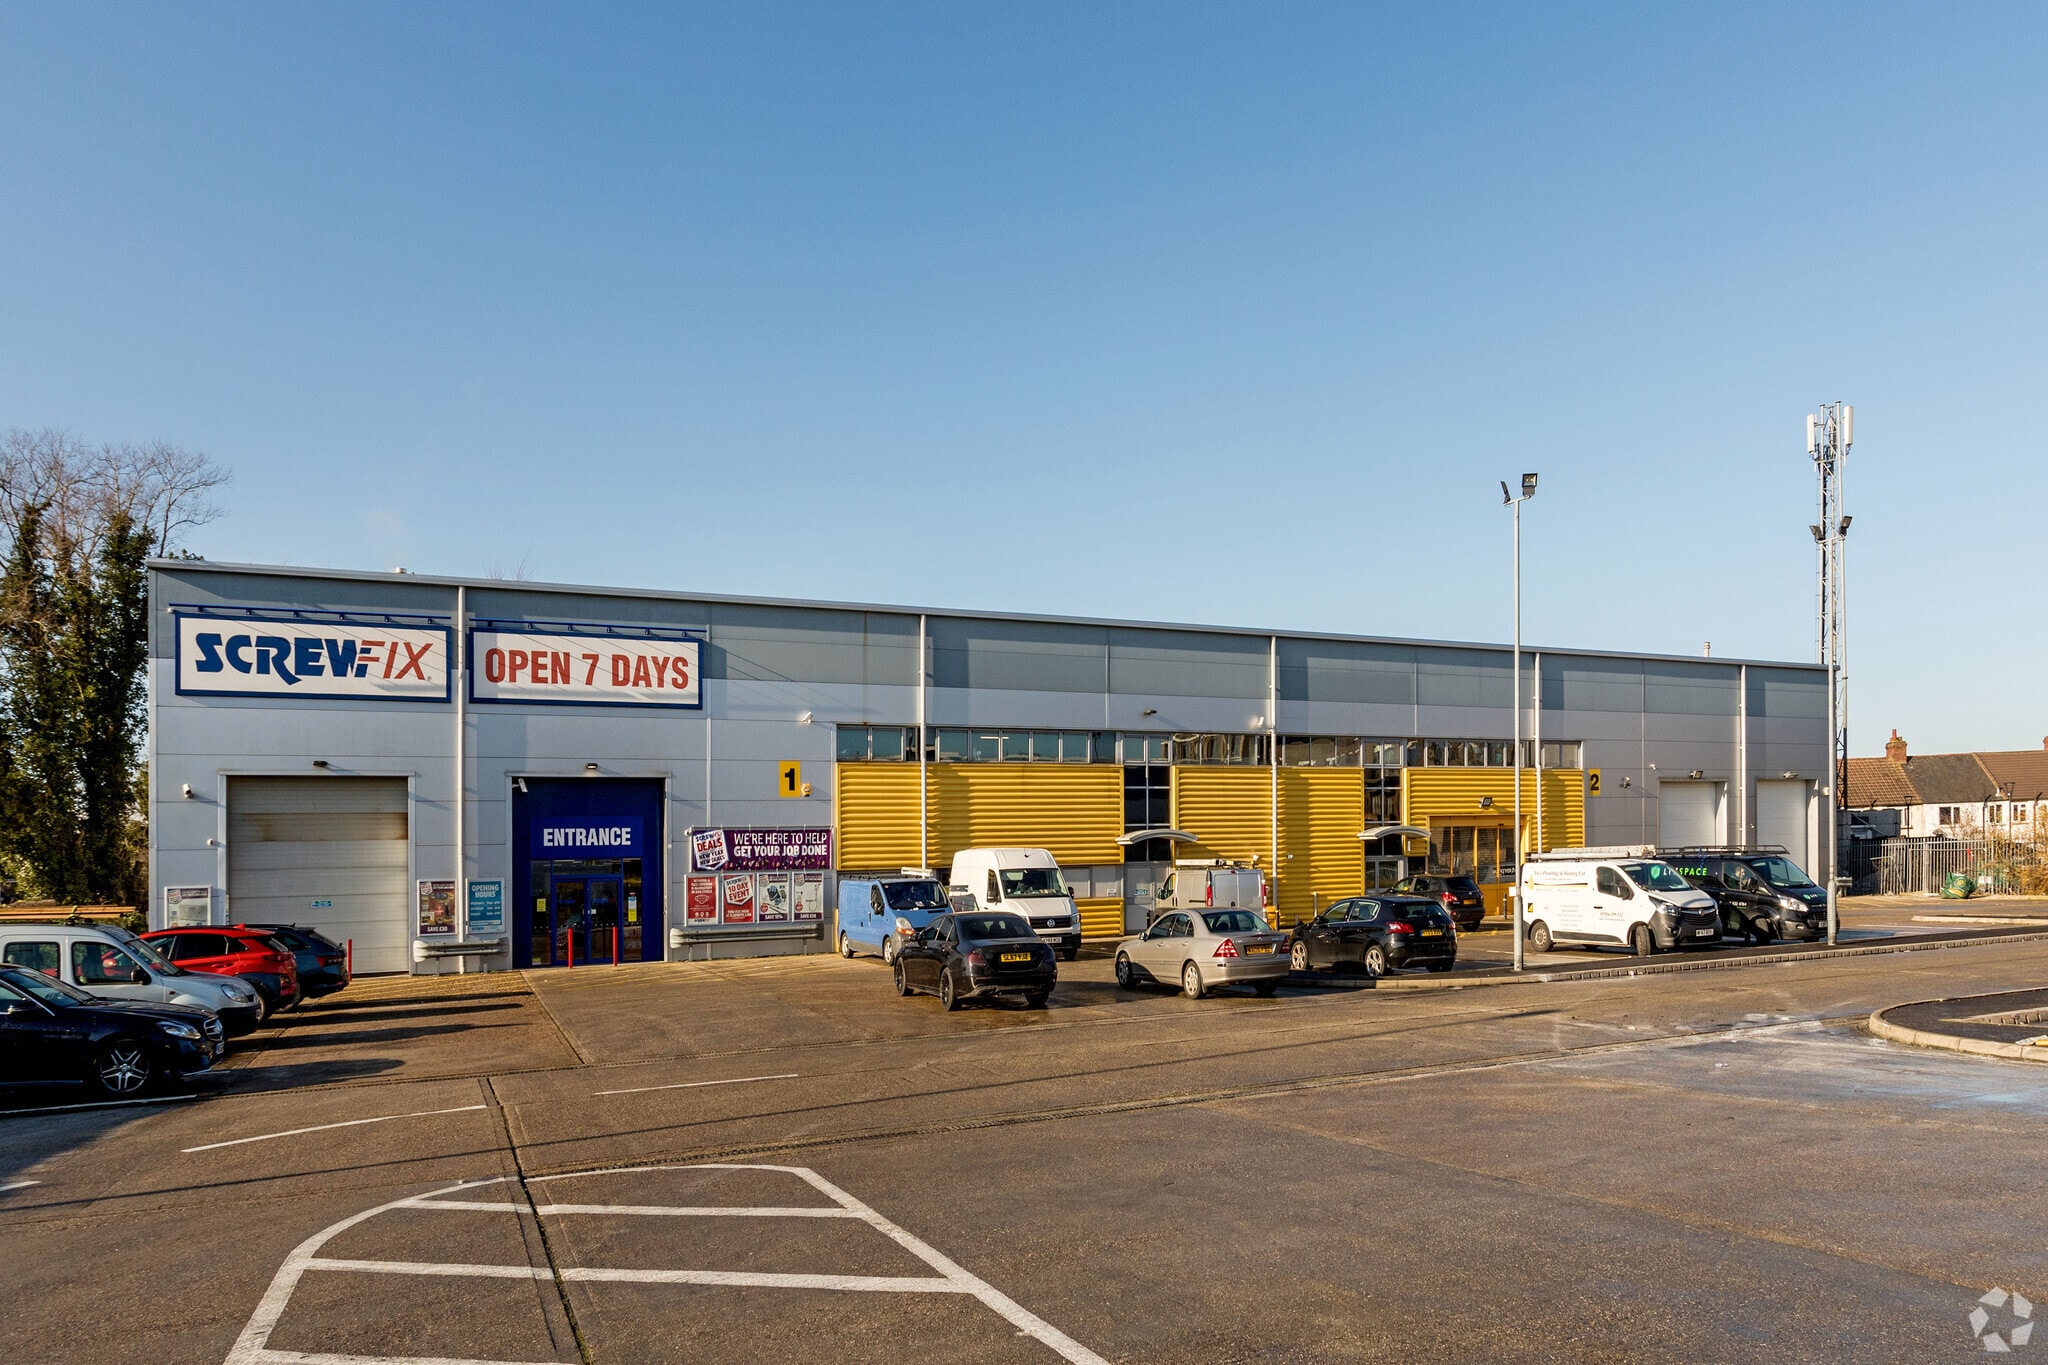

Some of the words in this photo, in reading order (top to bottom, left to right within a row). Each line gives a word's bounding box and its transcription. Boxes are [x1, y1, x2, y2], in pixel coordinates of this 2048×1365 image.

[195, 632, 434, 686] SCREWFIX
[485, 648, 571, 684] OPEN
[582, 653, 600, 686] 7
[612, 654, 689, 690] DAYS
[784, 768, 795, 791] 1
[1590, 774, 1600, 791] 2
[543, 827, 631, 847] ENTRANCE
[734, 833, 763, 845] WE'RE
[765, 833, 789, 844] HERE
[791, 833, 803, 844] TO
[805, 832, 828, 844] HELP
[697, 838, 723, 852] DEALS
[734, 846, 752, 857] GET
[753, 846, 780, 857] YOUR
[782, 845, 799, 856] JOB
[802, 844, 828, 856] DONE
[698, 852, 711, 860] NEW
[711, 849, 724, 857] YEAR
[1663, 867, 1708, 876] LISPACE
[471, 884, 499, 892] OPENING
[728, 885, 736, 893] 10
[736, 881, 749, 890] DAY
[729, 889, 750, 901] EVENT
